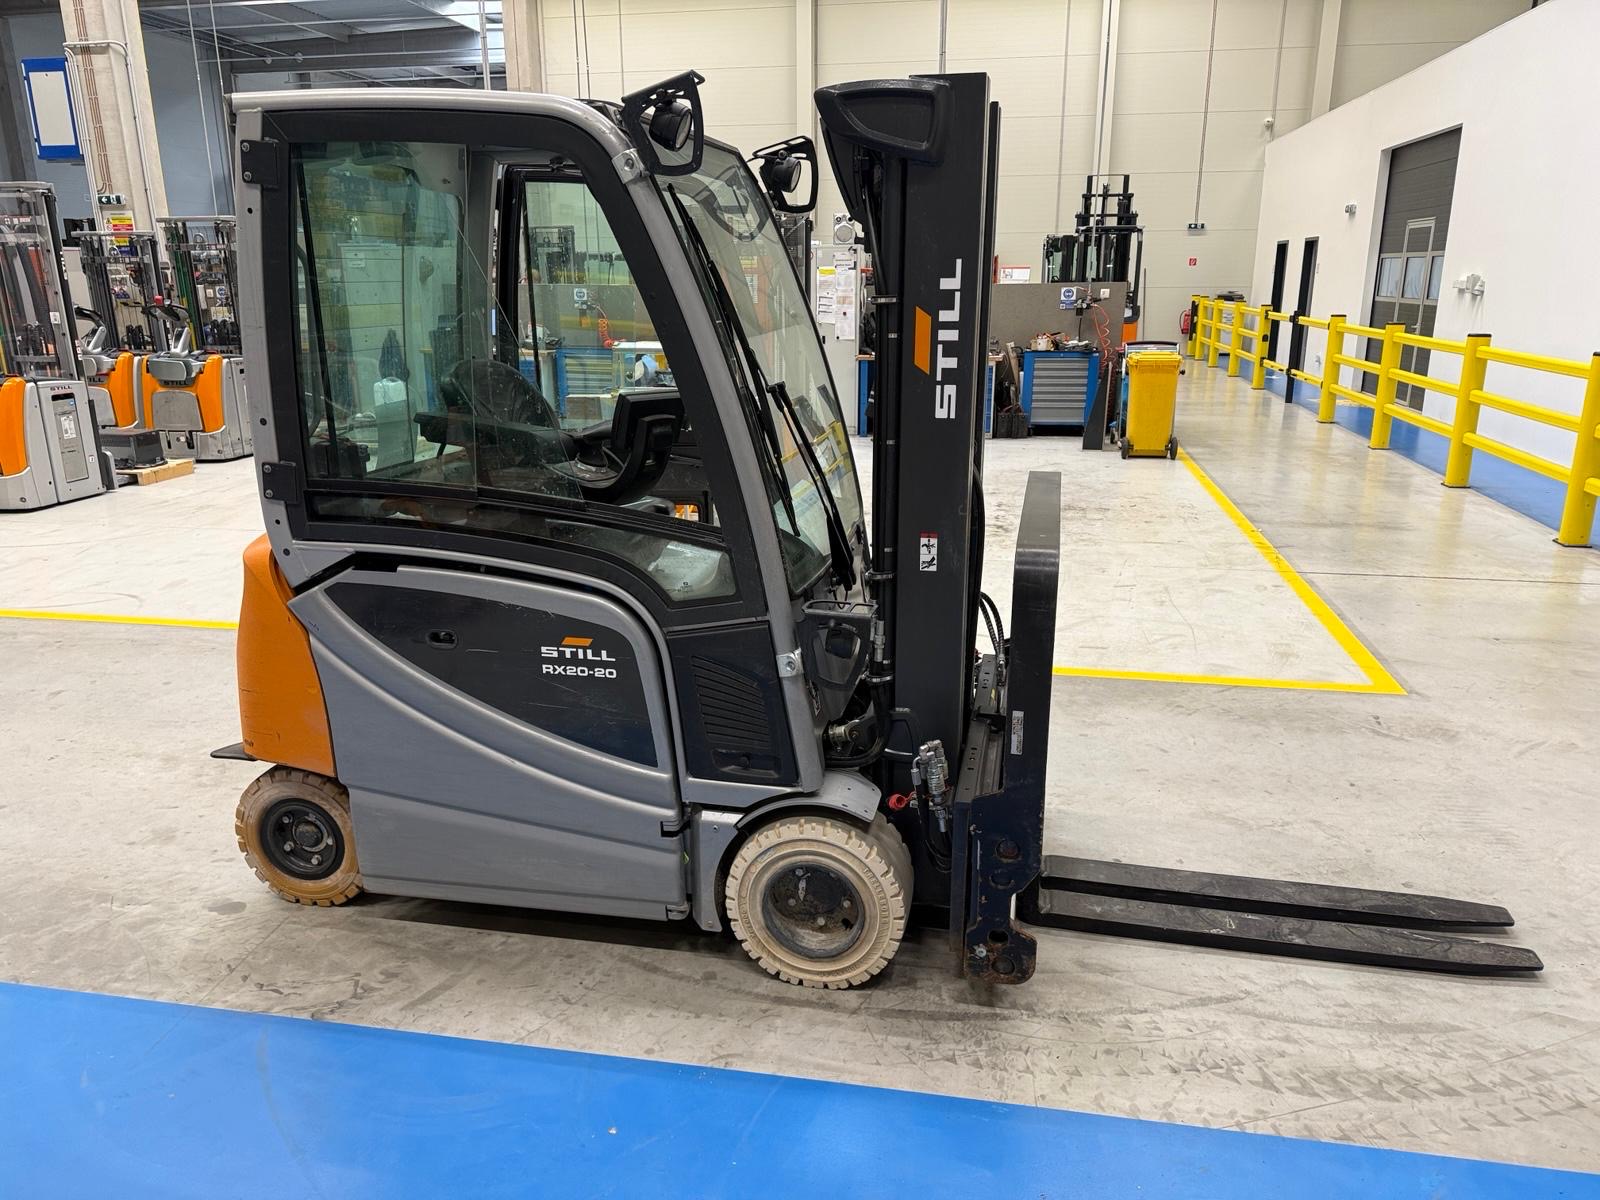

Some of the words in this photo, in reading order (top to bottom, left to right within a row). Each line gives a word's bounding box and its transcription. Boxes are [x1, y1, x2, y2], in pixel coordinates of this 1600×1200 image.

[935, 258, 963, 419] STILL
[540, 646, 616, 661] STILL
[542, 664, 617, 679] RX20-20
